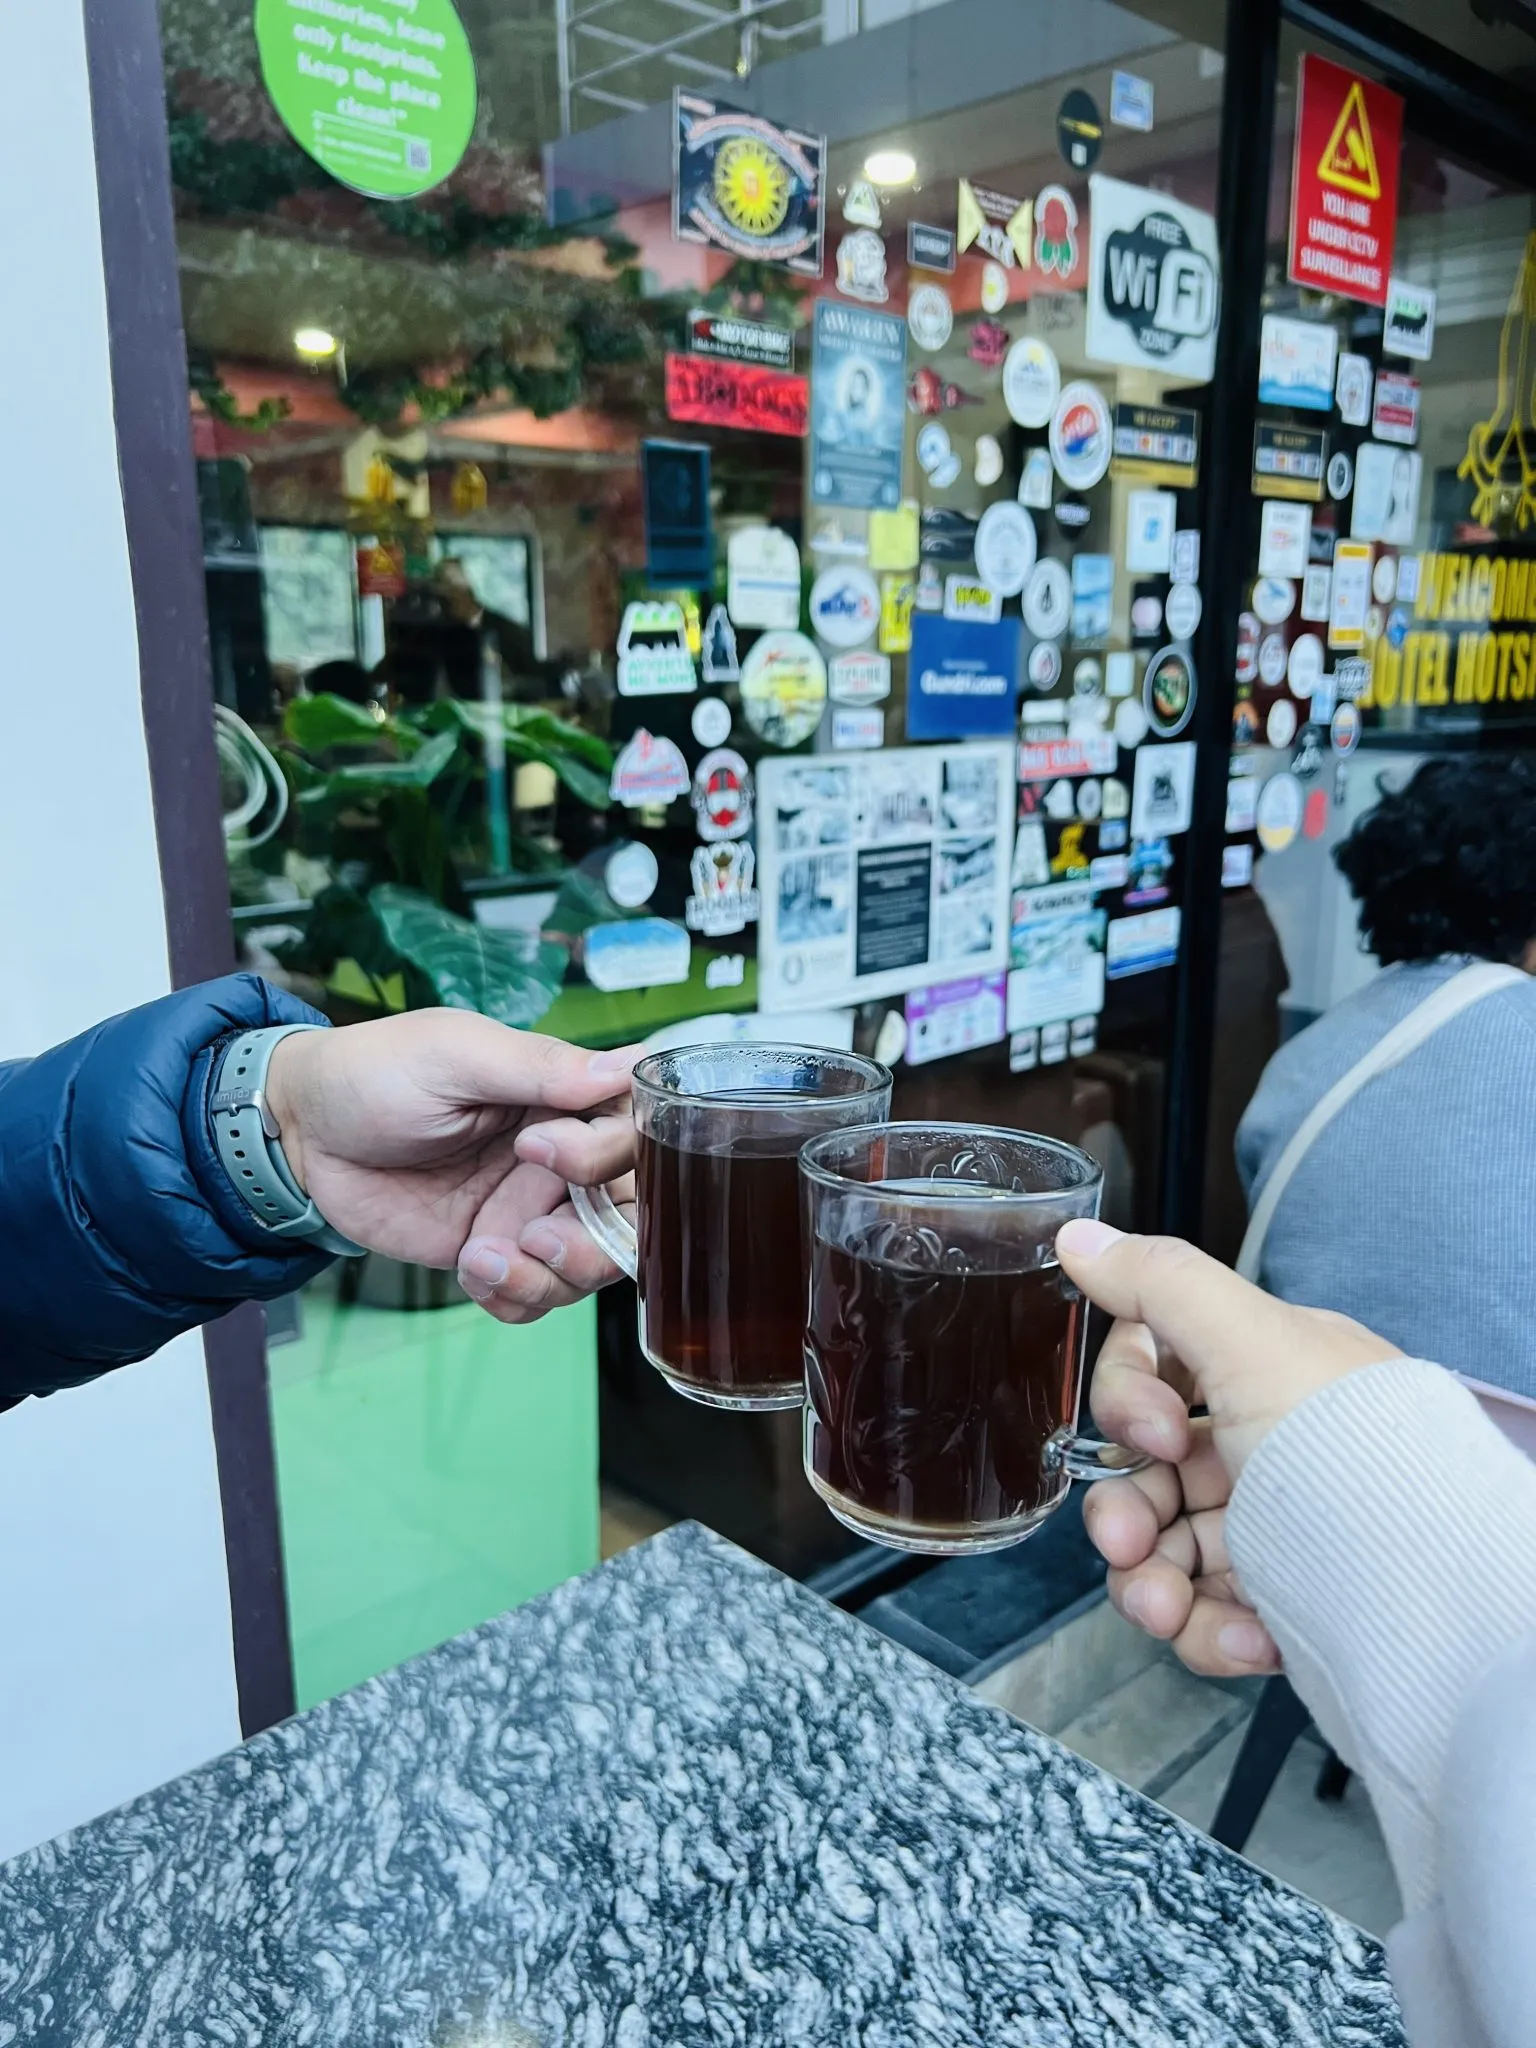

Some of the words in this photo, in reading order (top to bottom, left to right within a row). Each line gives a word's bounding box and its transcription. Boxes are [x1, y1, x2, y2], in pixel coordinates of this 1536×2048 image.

[297, 51, 349, 88] Keep
[1144, 217, 1183, 246] FREE
[1300, 246, 1382, 290] SURVEILLANCE
[1139, 326, 1176, 351] ZONE
